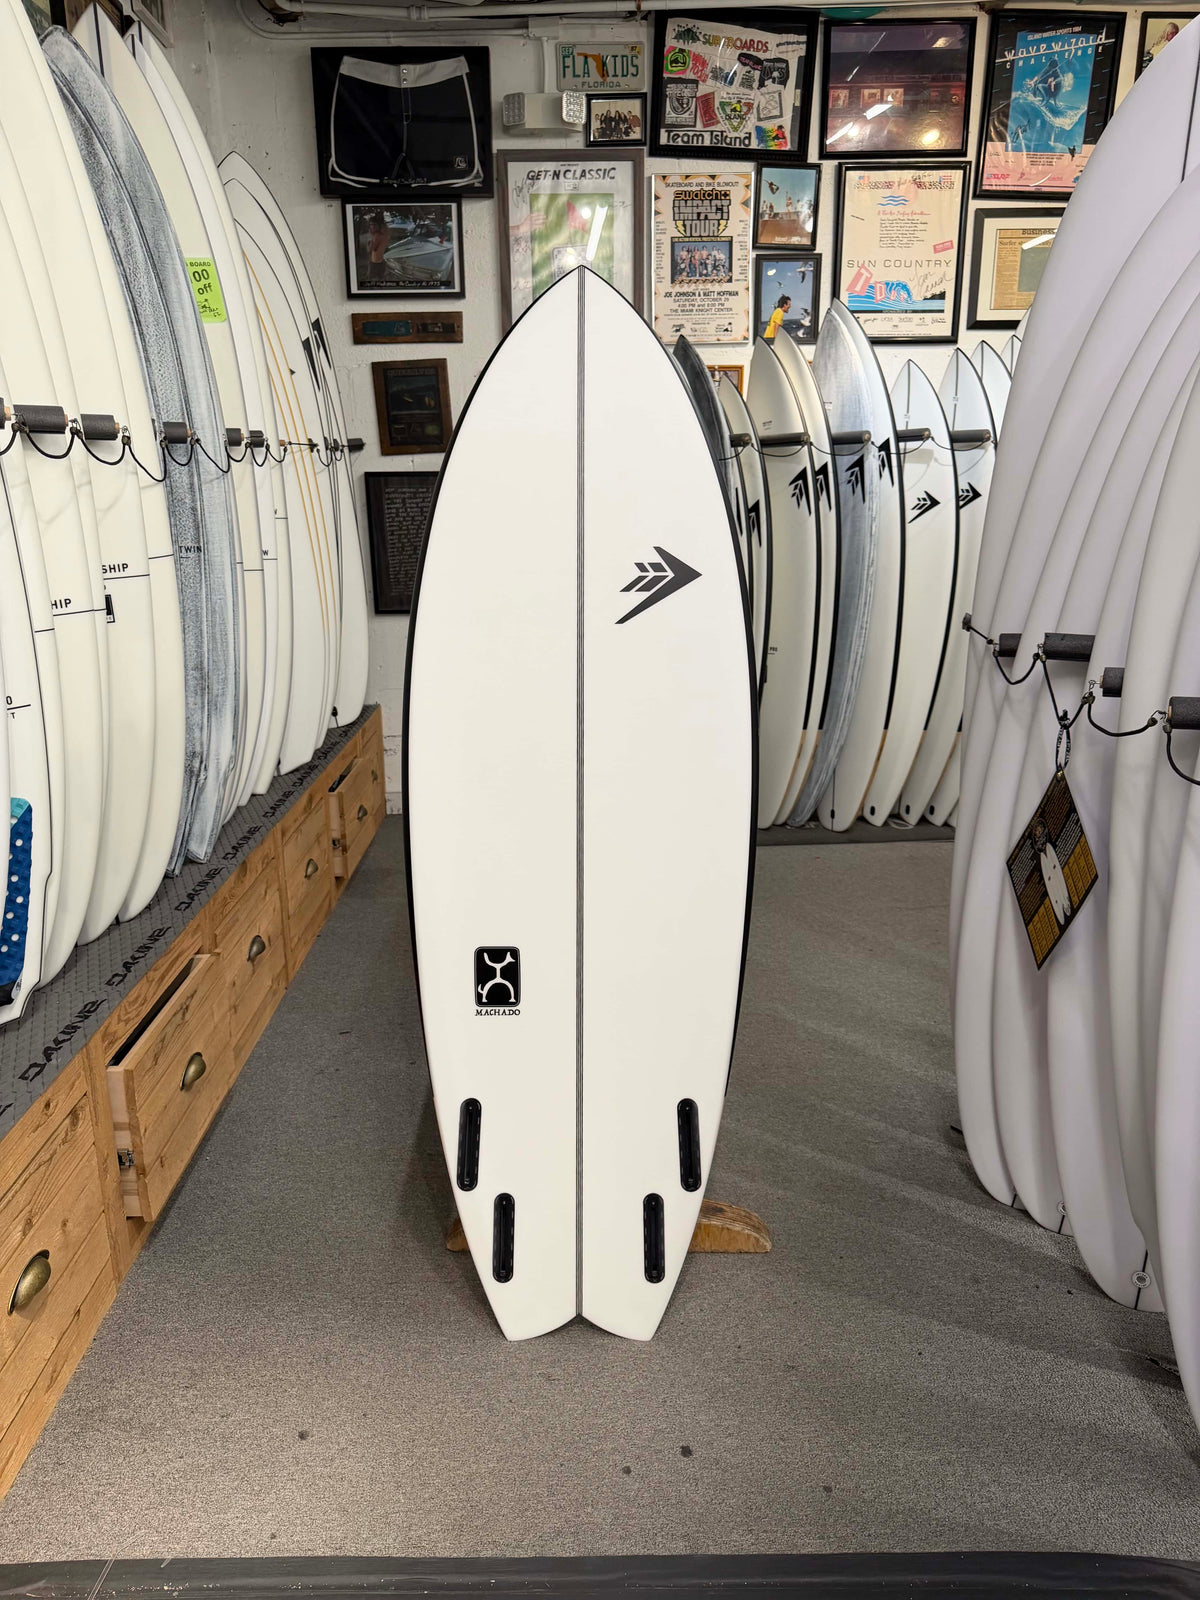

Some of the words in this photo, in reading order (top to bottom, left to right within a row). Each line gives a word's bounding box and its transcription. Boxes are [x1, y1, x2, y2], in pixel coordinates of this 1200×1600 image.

[562, 55, 590, 78] FLA
[601, 55, 639, 78] KIDS
[1006, 45, 1103, 69] CHALLENGE
[665, 130, 704, 144] Team
[709, 131, 752, 147] Island
[563, 167, 616, 180] CLASSIC
[674, 188, 721, 200] swatch
[673, 199, 731, 221] IMPACT
[684, 220, 720, 237] TOUR
[847, 260, 877, 268] SUN
[883, 259, 952, 268] COUNTRY
[197, 282, 213, 295] off
[179, 545, 203, 553] TWIN
[222, 825, 264, 861] DAKINE
[174, 866, 226, 912] DAKINE
[105, 926, 172, 987] DAKINE
[18, 998, 108, 1082] DAKINE
